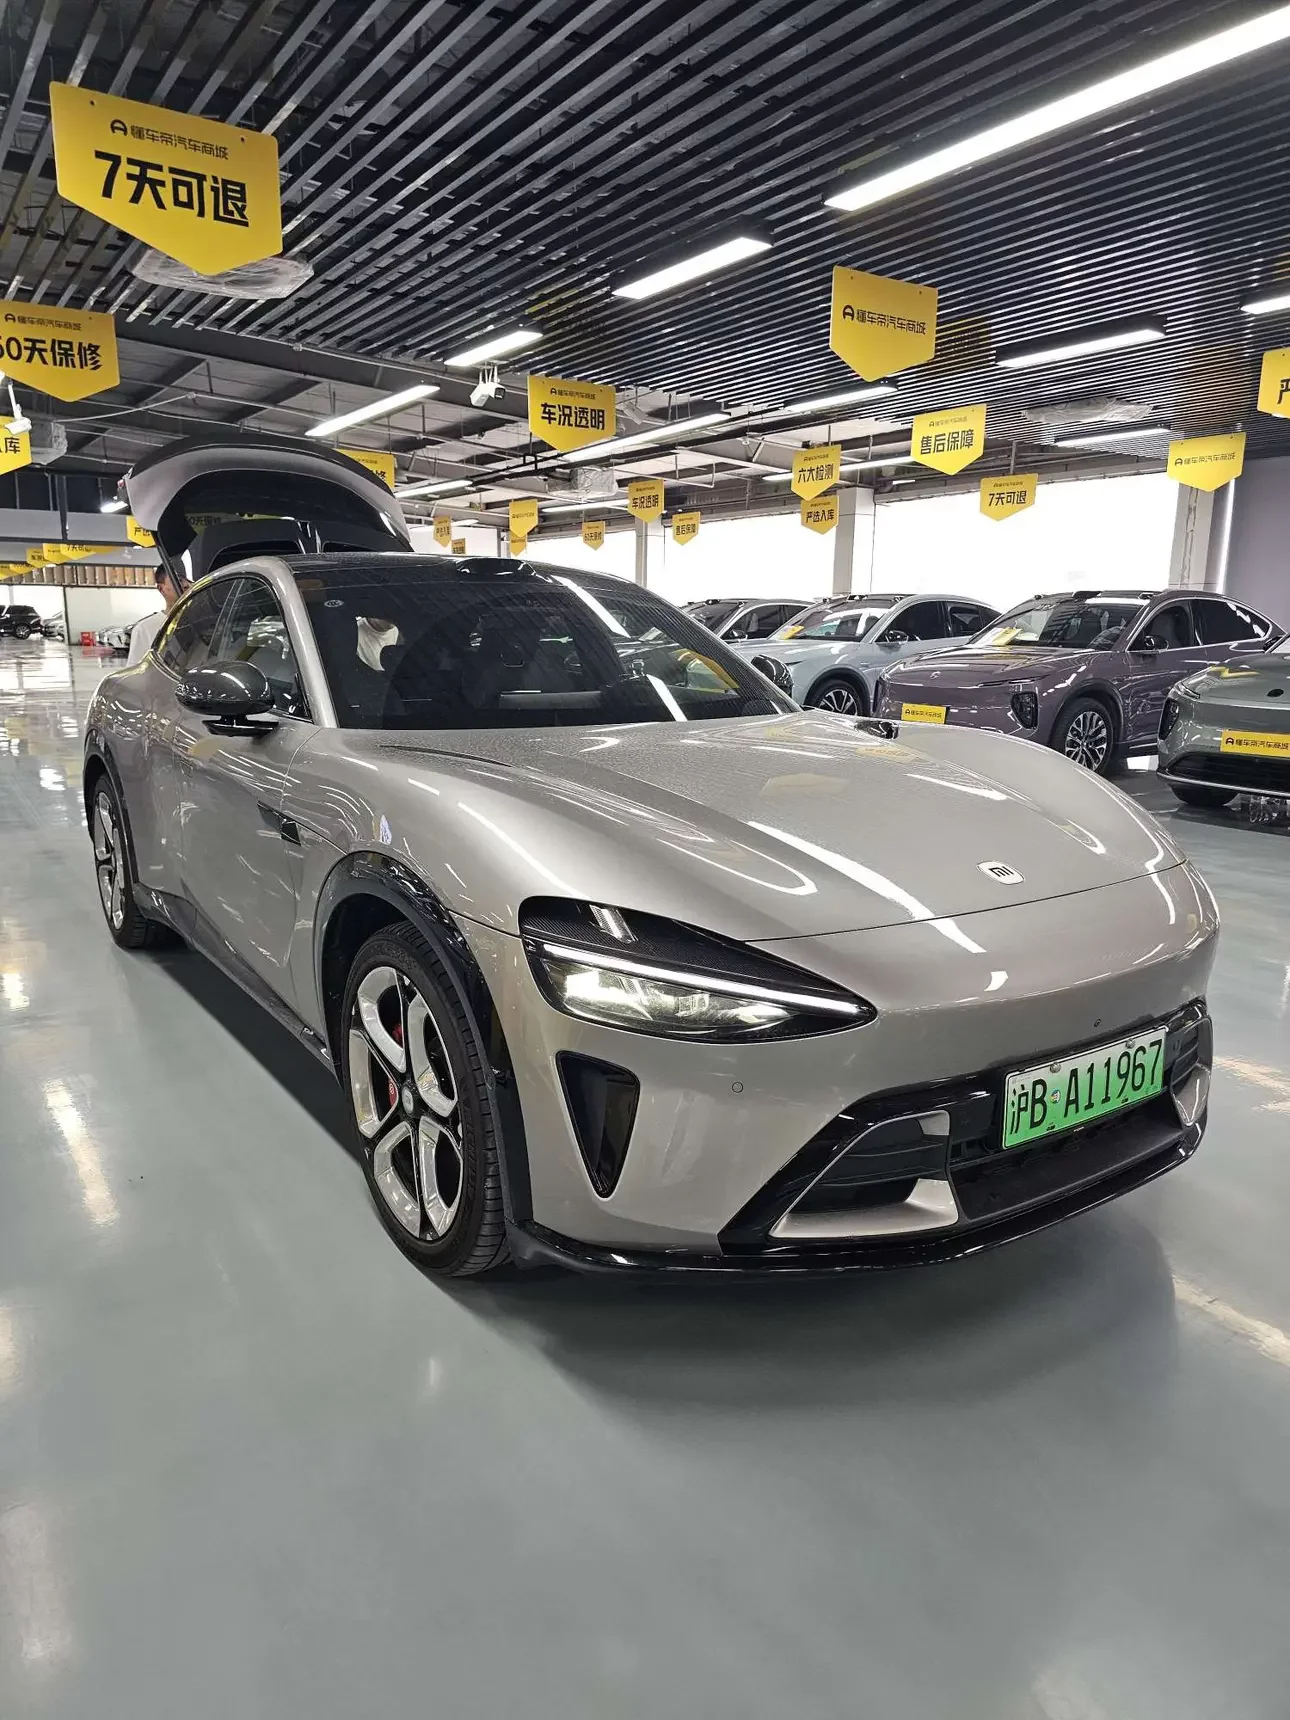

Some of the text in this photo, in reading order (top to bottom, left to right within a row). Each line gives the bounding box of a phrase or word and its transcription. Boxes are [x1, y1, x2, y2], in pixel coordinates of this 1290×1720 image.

[130, 124, 229, 160] 懂车帝汽车商城
[94, 149, 249, 228] 7天可退
[856, 309, 926, 335] 懂车帝汽车商城
[0, 335, 103, 371] 0天保修
[541, 402, 605, 430] 车况透明
[0, 436, 21, 454] 库
[920, 428, 974, 455] 售后保障
[797, 463, 834, 483] 六大检测
[632, 494, 658, 509] 车况透明
[988, 490, 1027, 507] 7天可退
[805, 509, 835, 523] 严选入库
